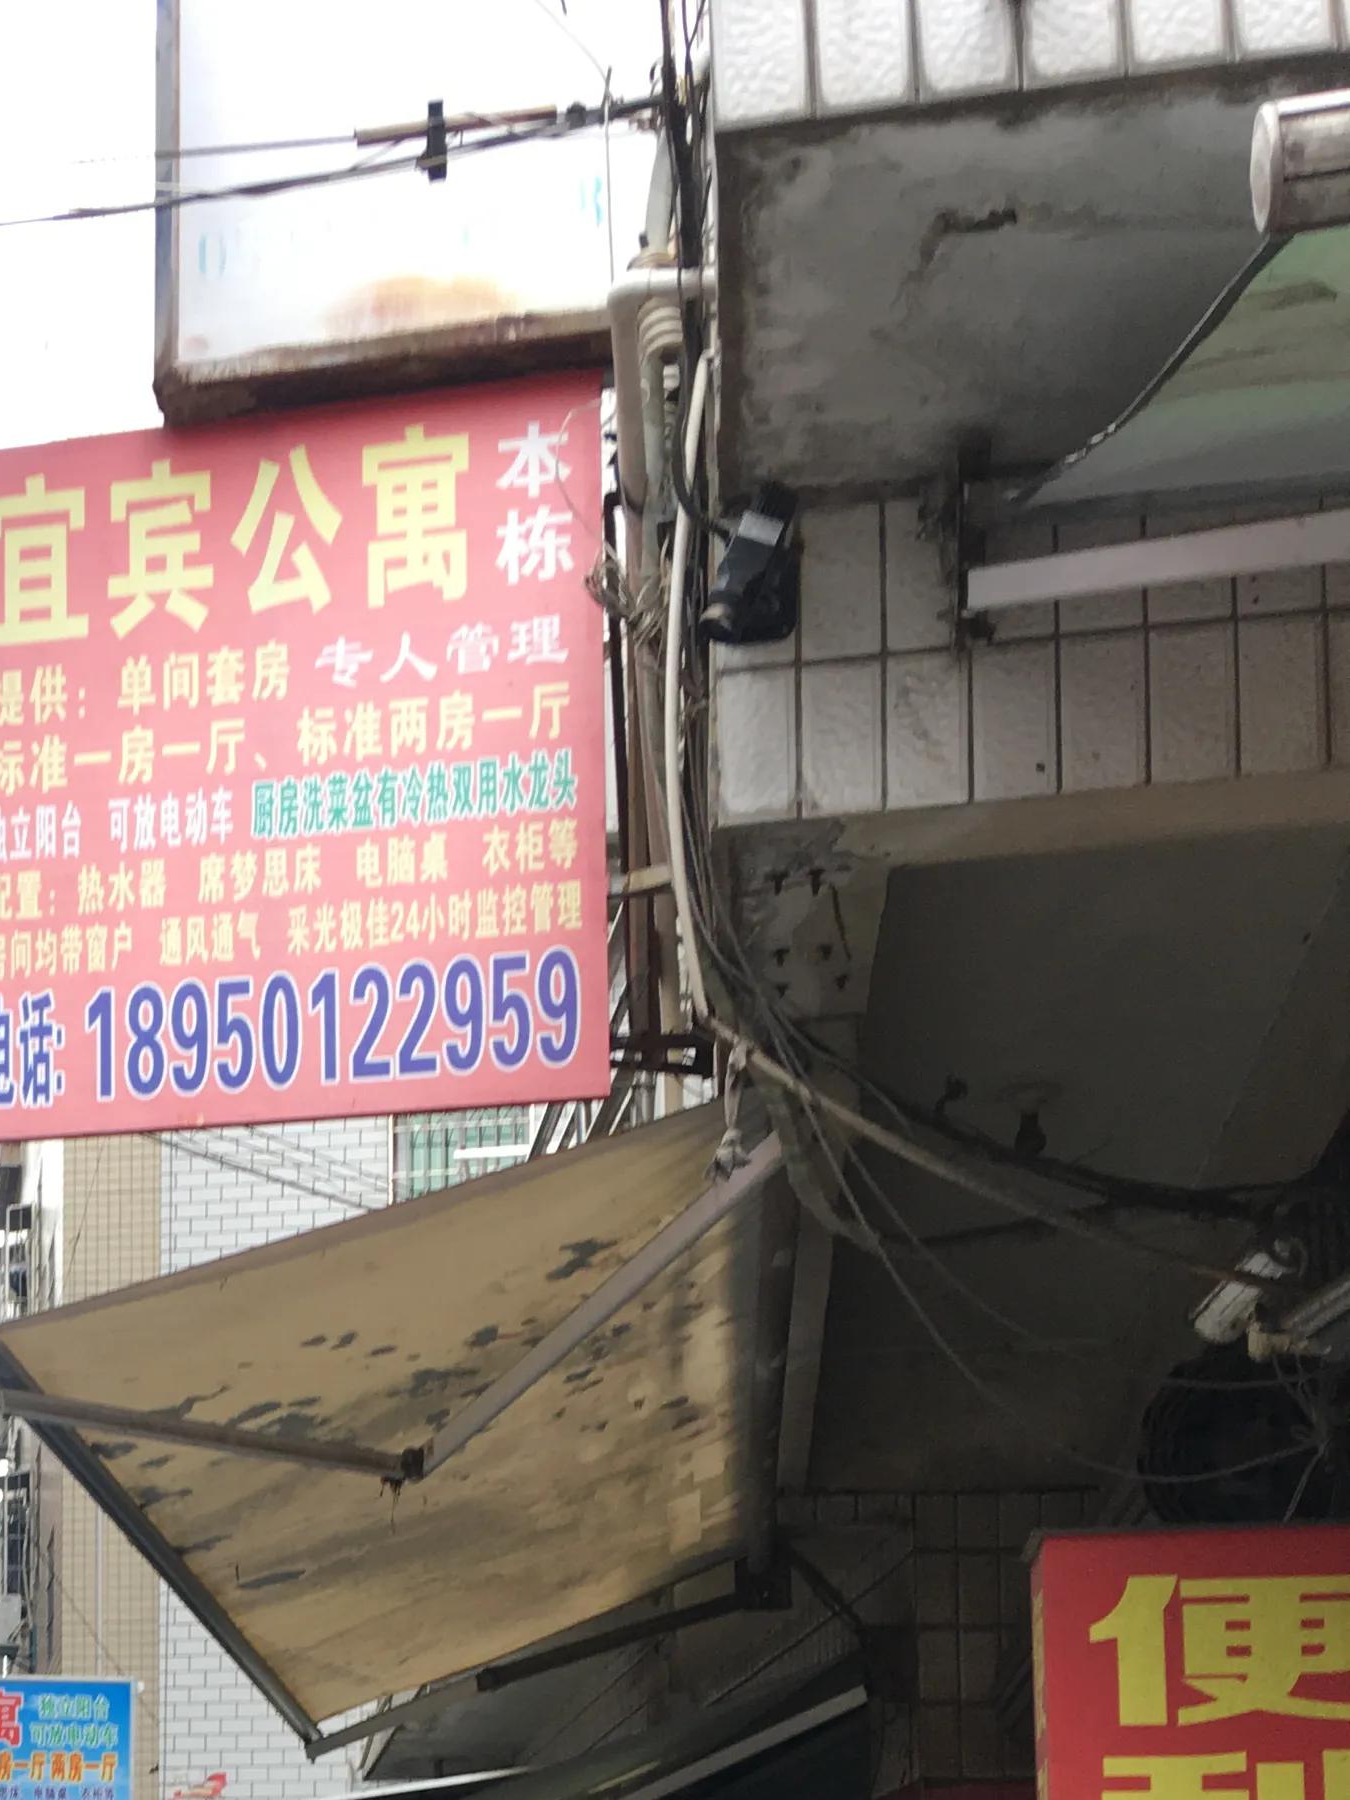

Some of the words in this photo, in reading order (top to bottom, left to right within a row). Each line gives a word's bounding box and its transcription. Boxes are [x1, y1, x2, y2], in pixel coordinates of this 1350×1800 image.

[495, 420, 573, 584] 本栋
[315, 615, 570, 688] 专人管理
[108, 786, 233, 853] 可放电动车
[251, 748, 578, 839] 厨房洗菜盆有冷热双用水龙头
[198, 843, 321, 904] 席梦思床
[356, 832, 448, 888] 电脑桌
[483, 818, 578, 877] 衣柜等
[160, 909, 261, 966] 通风通气
[85, 946, 580, 1101] 18950122959
[51, 1751, 116, 1782] 两房一厅
